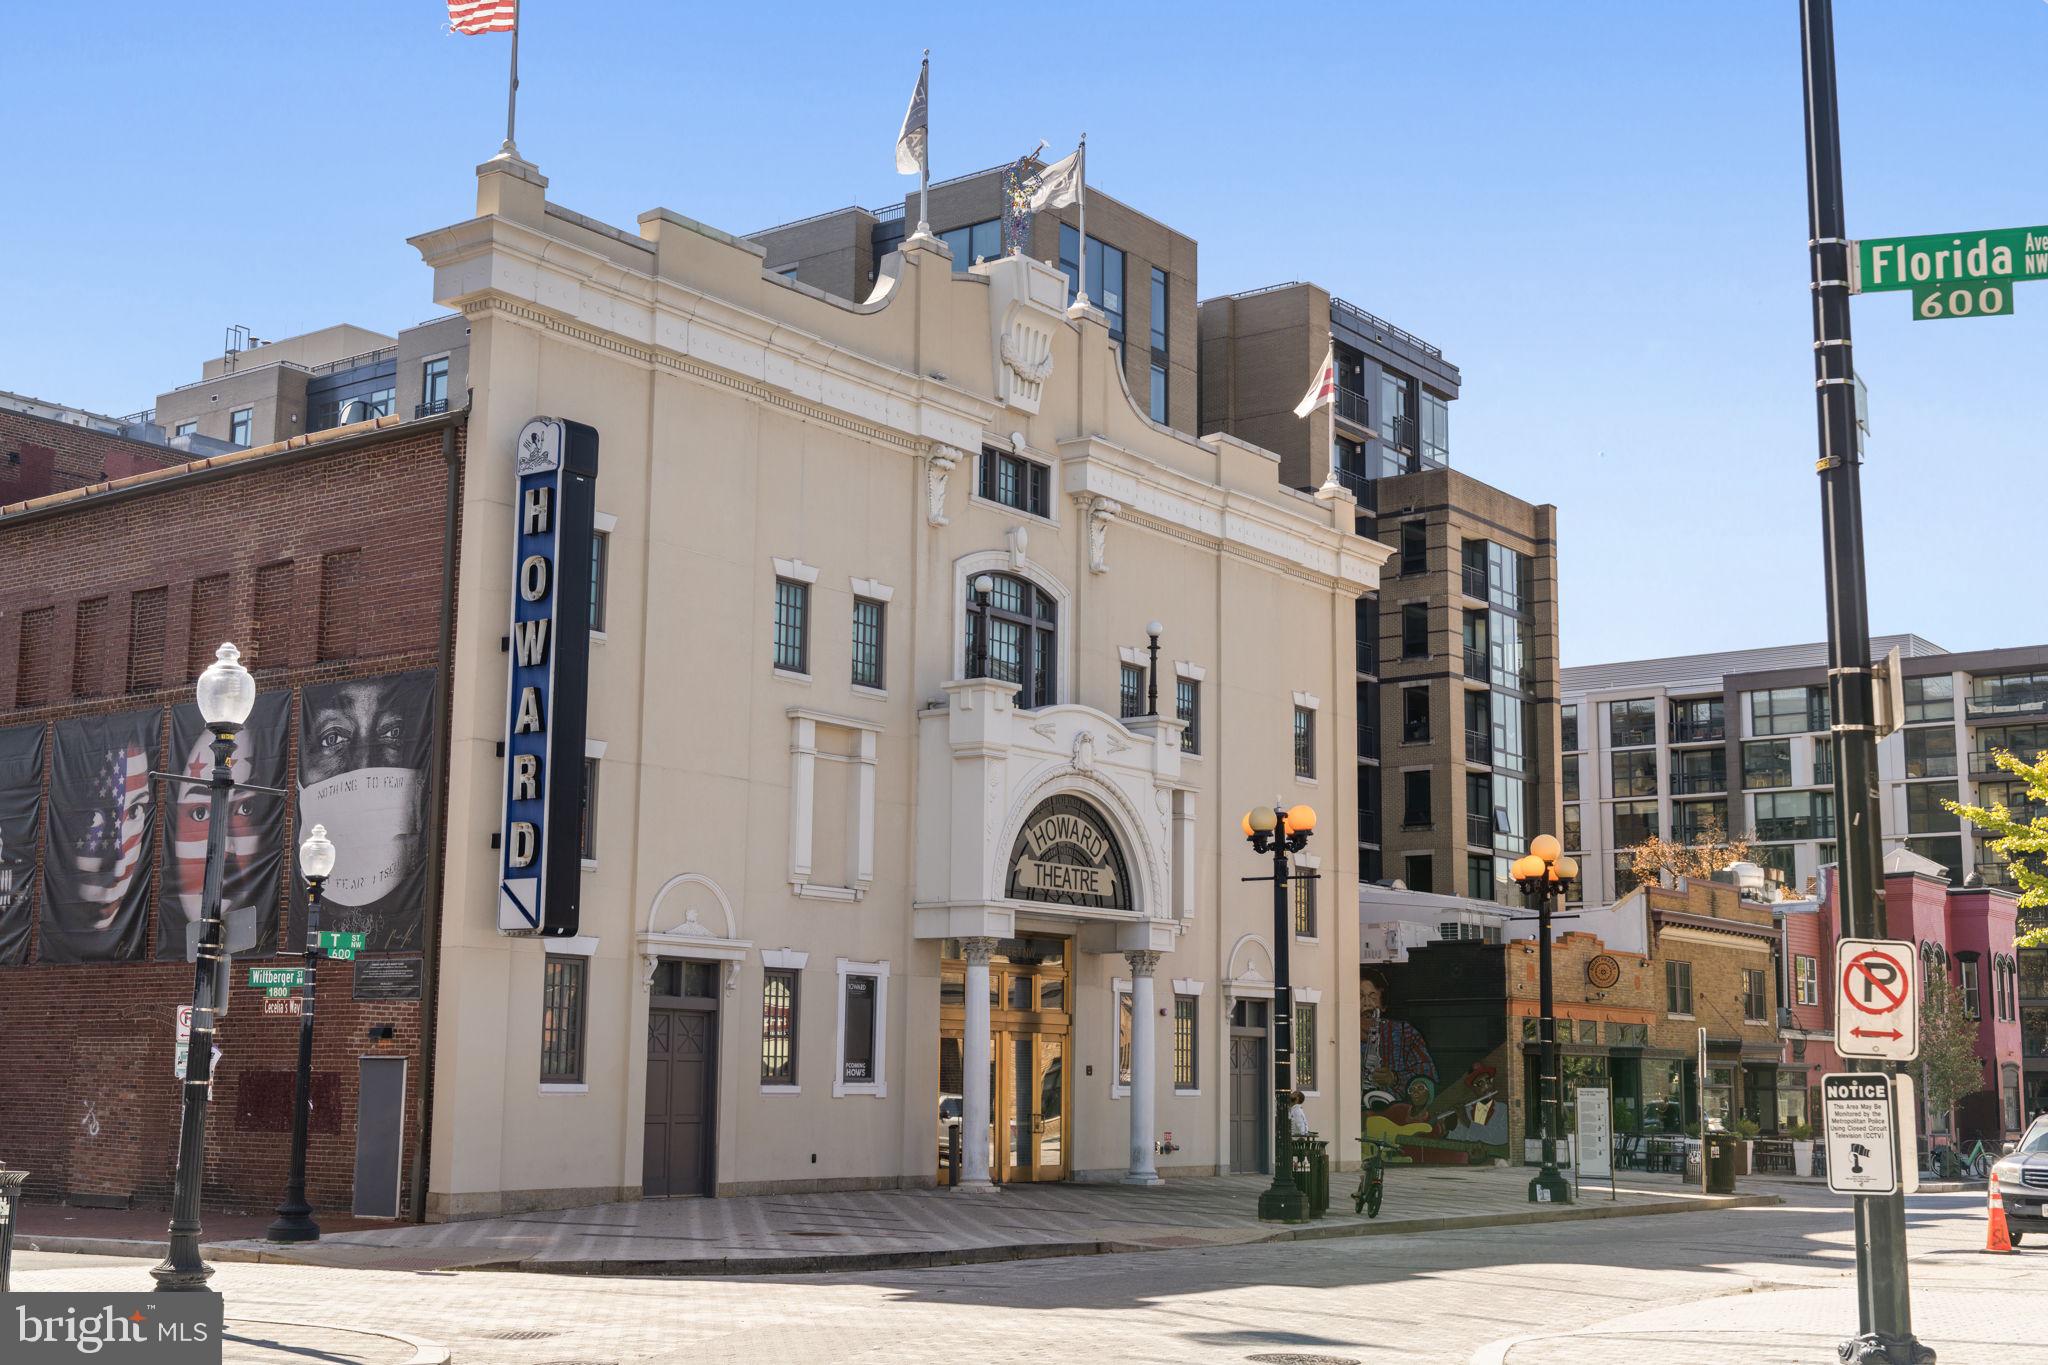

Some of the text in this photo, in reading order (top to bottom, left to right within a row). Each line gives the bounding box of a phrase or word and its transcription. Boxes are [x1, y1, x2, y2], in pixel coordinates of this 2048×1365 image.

[2025, 232, 2048, 252] Ave
[1872, 238, 2012, 284] Florida
[2025, 253, 2048, 274] NW
[1920, 287, 2003, 318] 600
[509, 486, 553, 869] HOWARD
[317, 776, 405, 801] NOTHING TO FEAR
[1033, 816, 1103, 858] HOWARD
[1033, 863, 1099, 893] THEATRE
[331, 933, 340, 947] T
[351, 934, 361, 942] ST
[332, 949, 351, 959] 600
[252, 969, 294, 987] Wiltberger
[268, 987, 288, 997] 1800
[264, 1000, 301, 1016] Cecelia's Way
[1826, 1085, 1886, 1099] NOTICE
[1860, 1103, 1872, 1111] May
